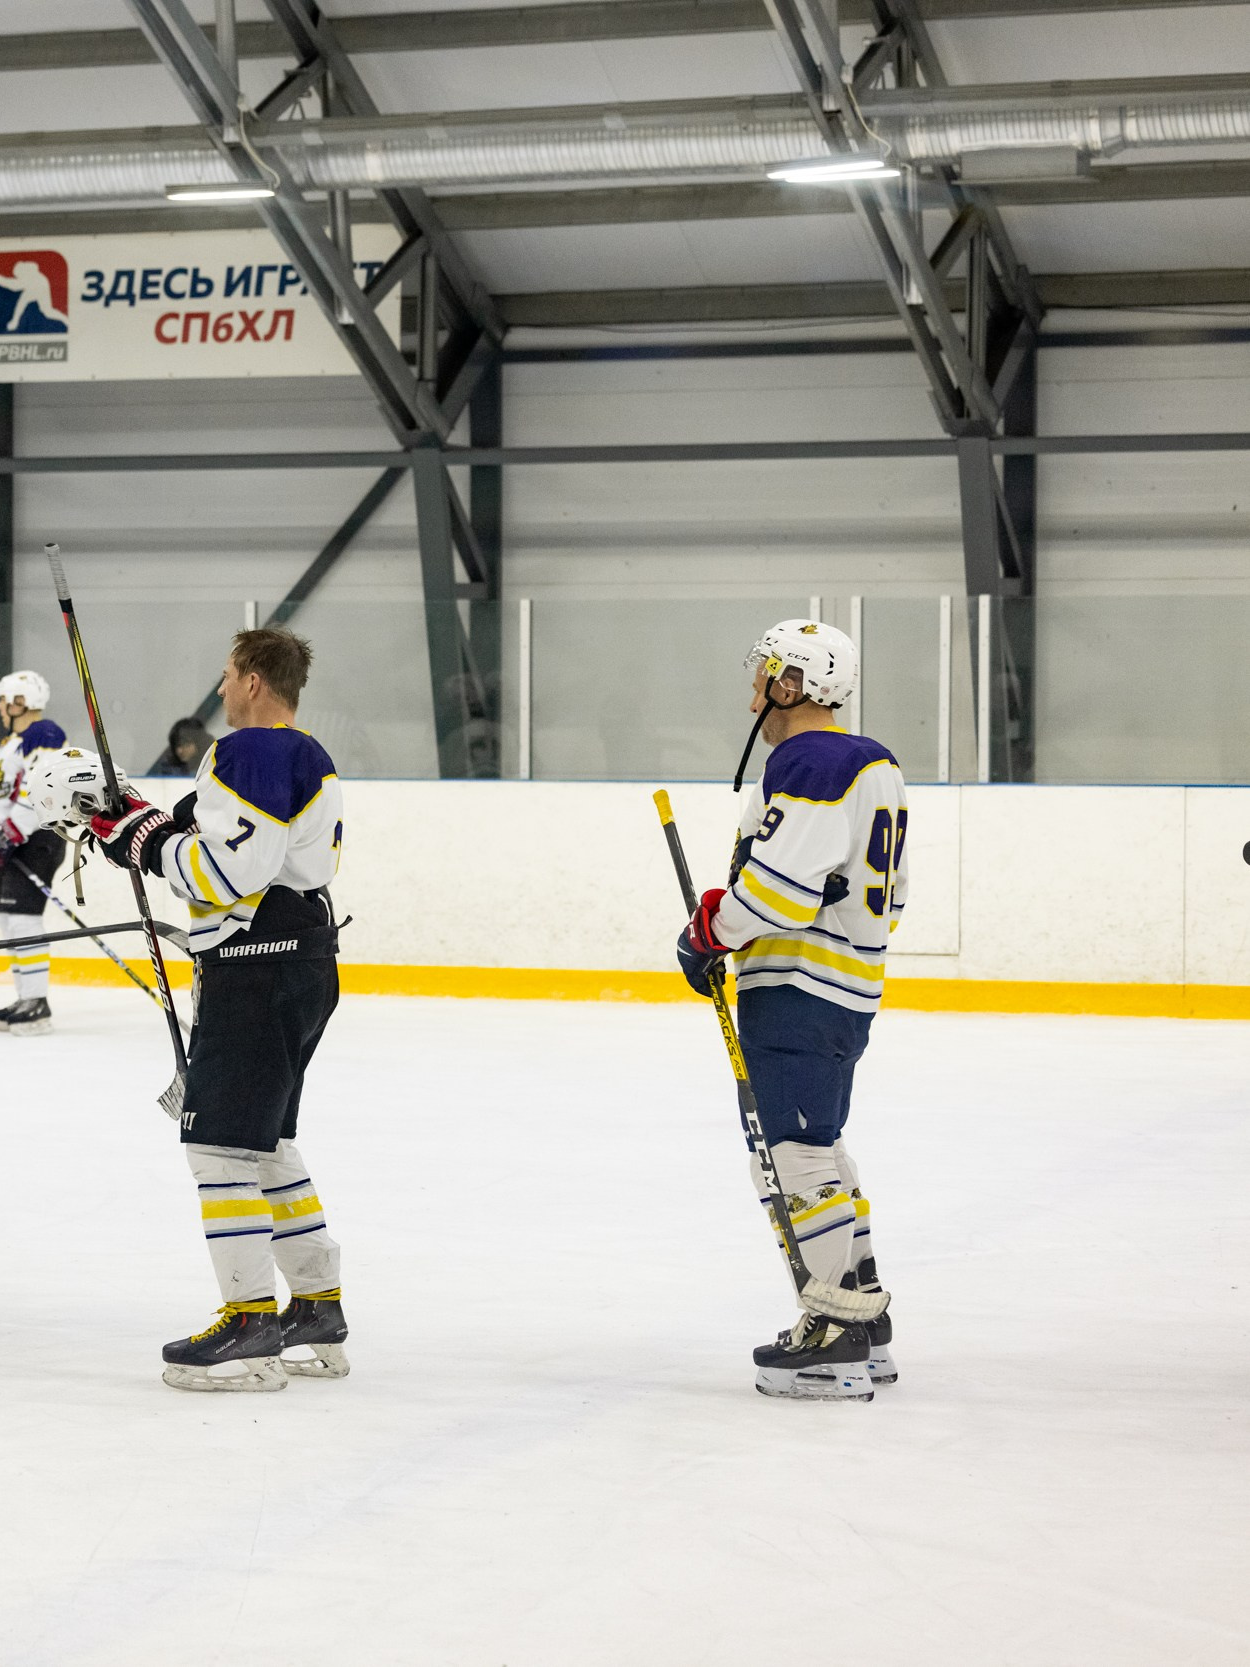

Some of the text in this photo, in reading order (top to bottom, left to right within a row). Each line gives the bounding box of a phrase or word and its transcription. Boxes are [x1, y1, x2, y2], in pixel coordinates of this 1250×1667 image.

[81, 261, 384, 308] ЗДЕСЬ ИГРТ
[787, 652, 810, 662] CCM
[225, 816, 256, 852] 7
[219, 938, 299, 959] WARRIOR
[745, 1109, 780, 1195] CCM
[215, 1338, 237, 1354] BAUER
